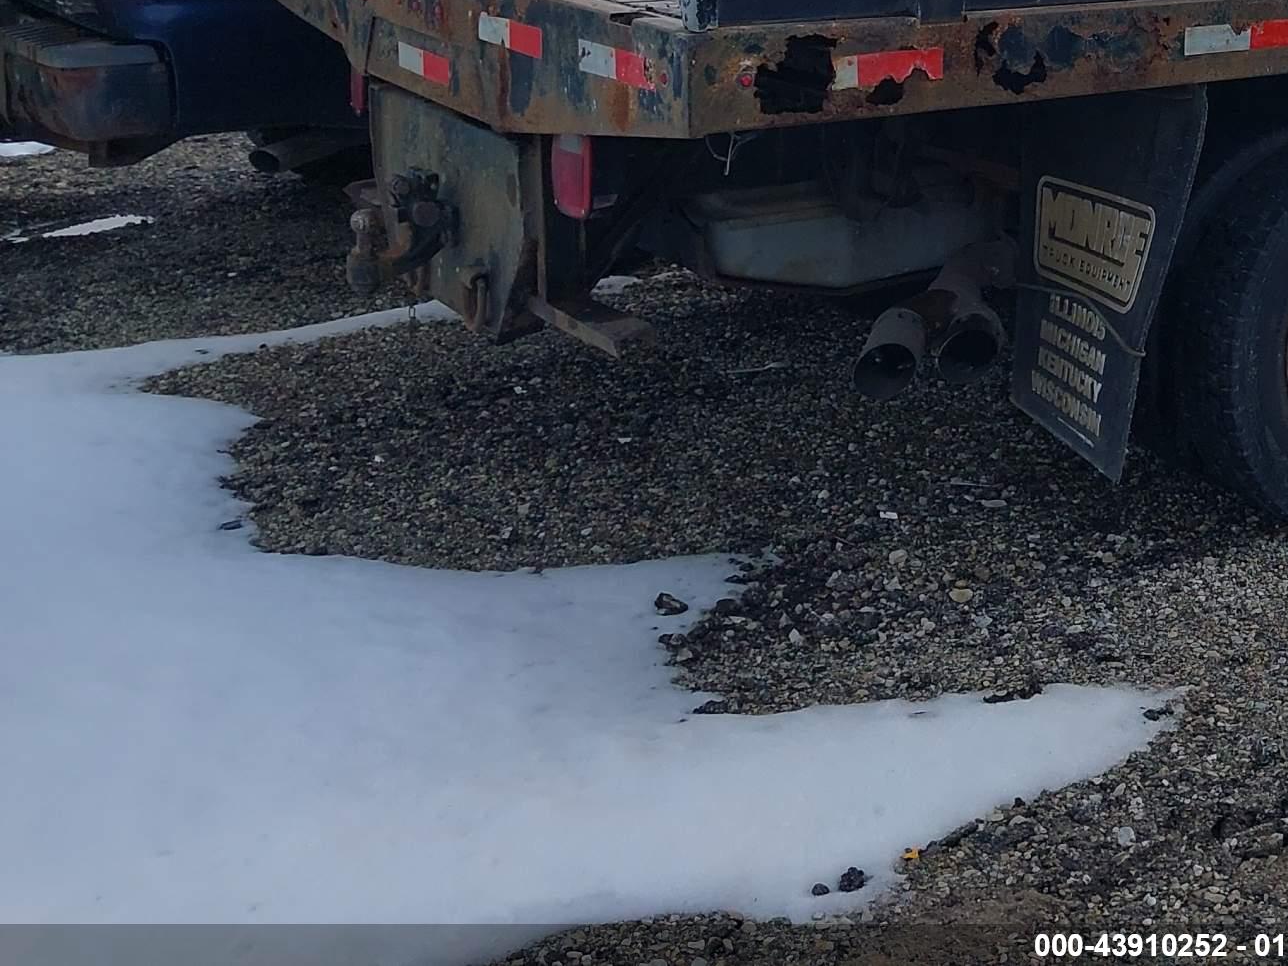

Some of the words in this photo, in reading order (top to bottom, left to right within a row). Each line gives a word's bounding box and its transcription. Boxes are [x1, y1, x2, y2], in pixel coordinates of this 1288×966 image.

[1041, 186, 1152, 265] MONROE
[1042, 244, 1076, 267] TRUCK
[1079, 259, 1132, 292] EQUIPMENT
[1049, 293, 1106, 341] ILLINOIS
[1038, 345, 1102, 404] KENTUCKY
[1040, 318, 1106, 375] MICHIGAN
[1031, 369, 1101, 437] WISCONSIN
